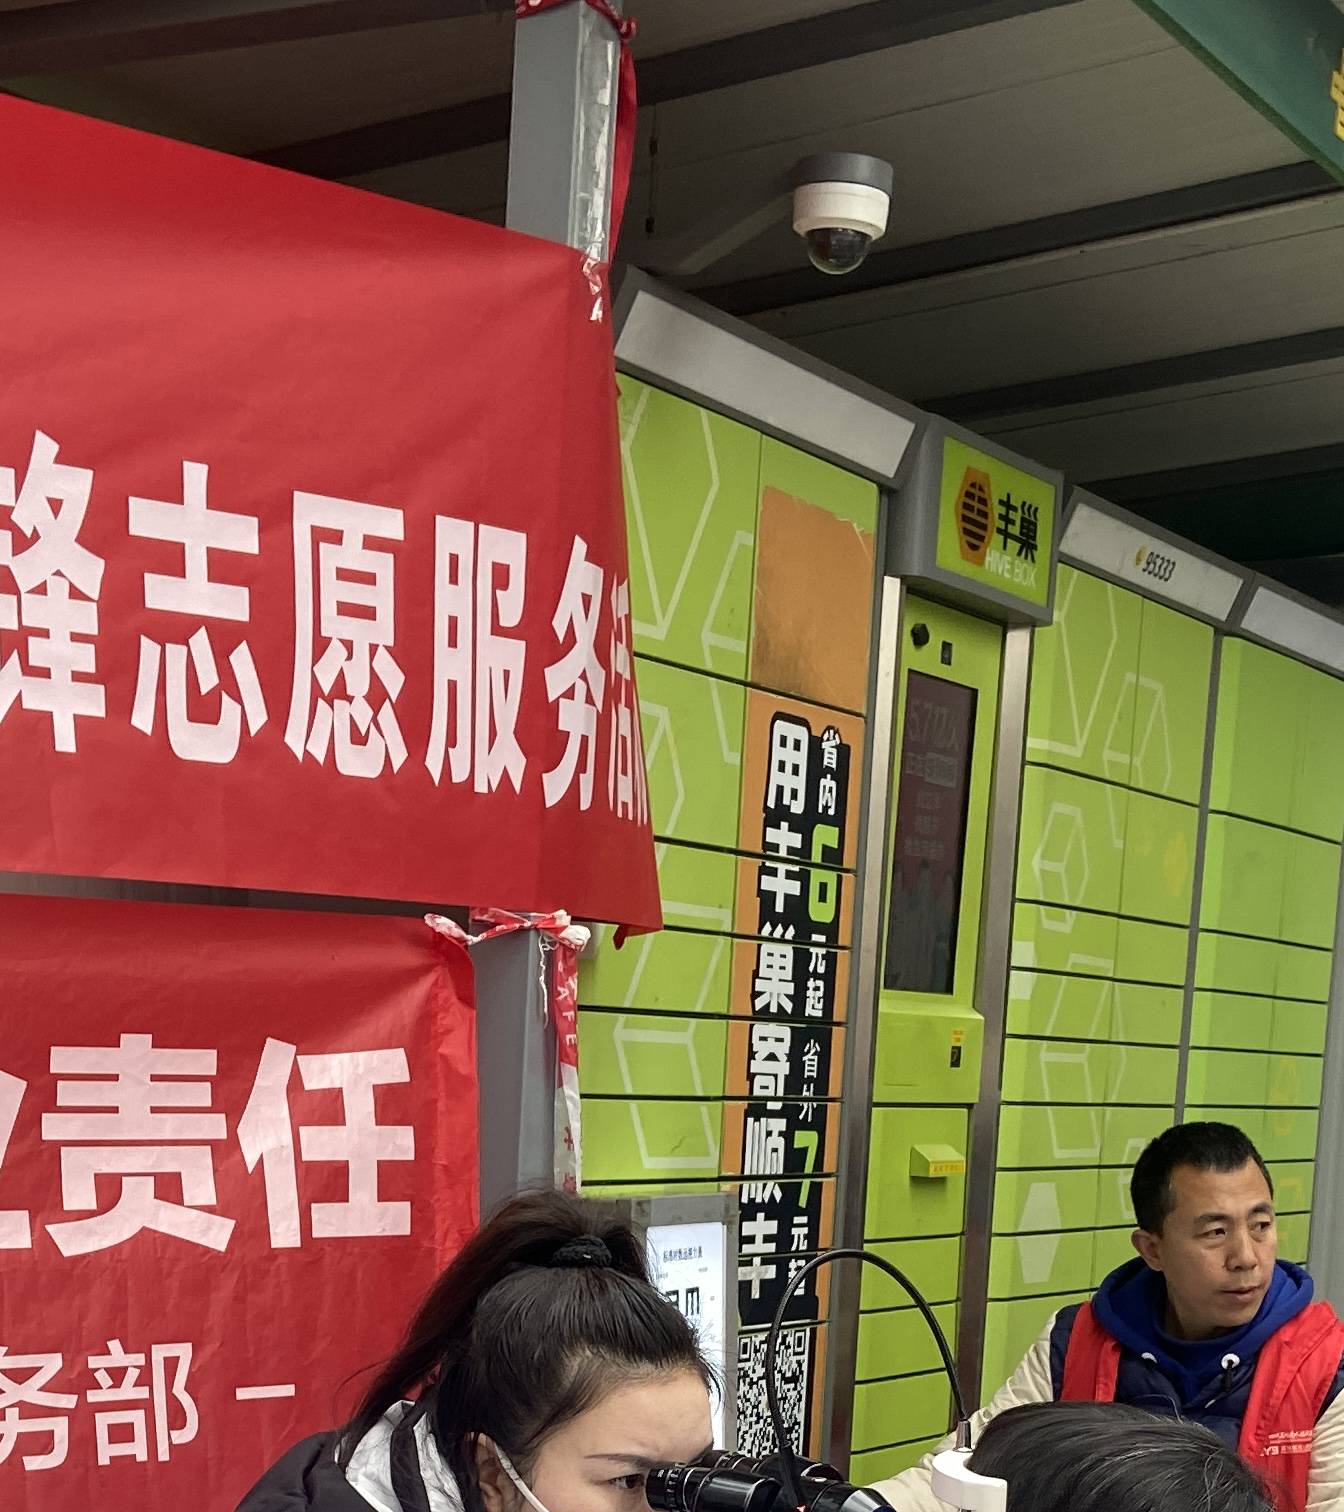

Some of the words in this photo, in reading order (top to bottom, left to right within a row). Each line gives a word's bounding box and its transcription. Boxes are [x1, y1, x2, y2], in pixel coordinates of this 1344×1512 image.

[996, 492, 1039, 563] 丰巢
[984, 549, 1013, 580] HIVE
[1012, 556, 1038, 590] BOX
[1141, 551, 1177, 582] 95333
[738, 719, 809, 1300] 用丰巢寄顺丰
